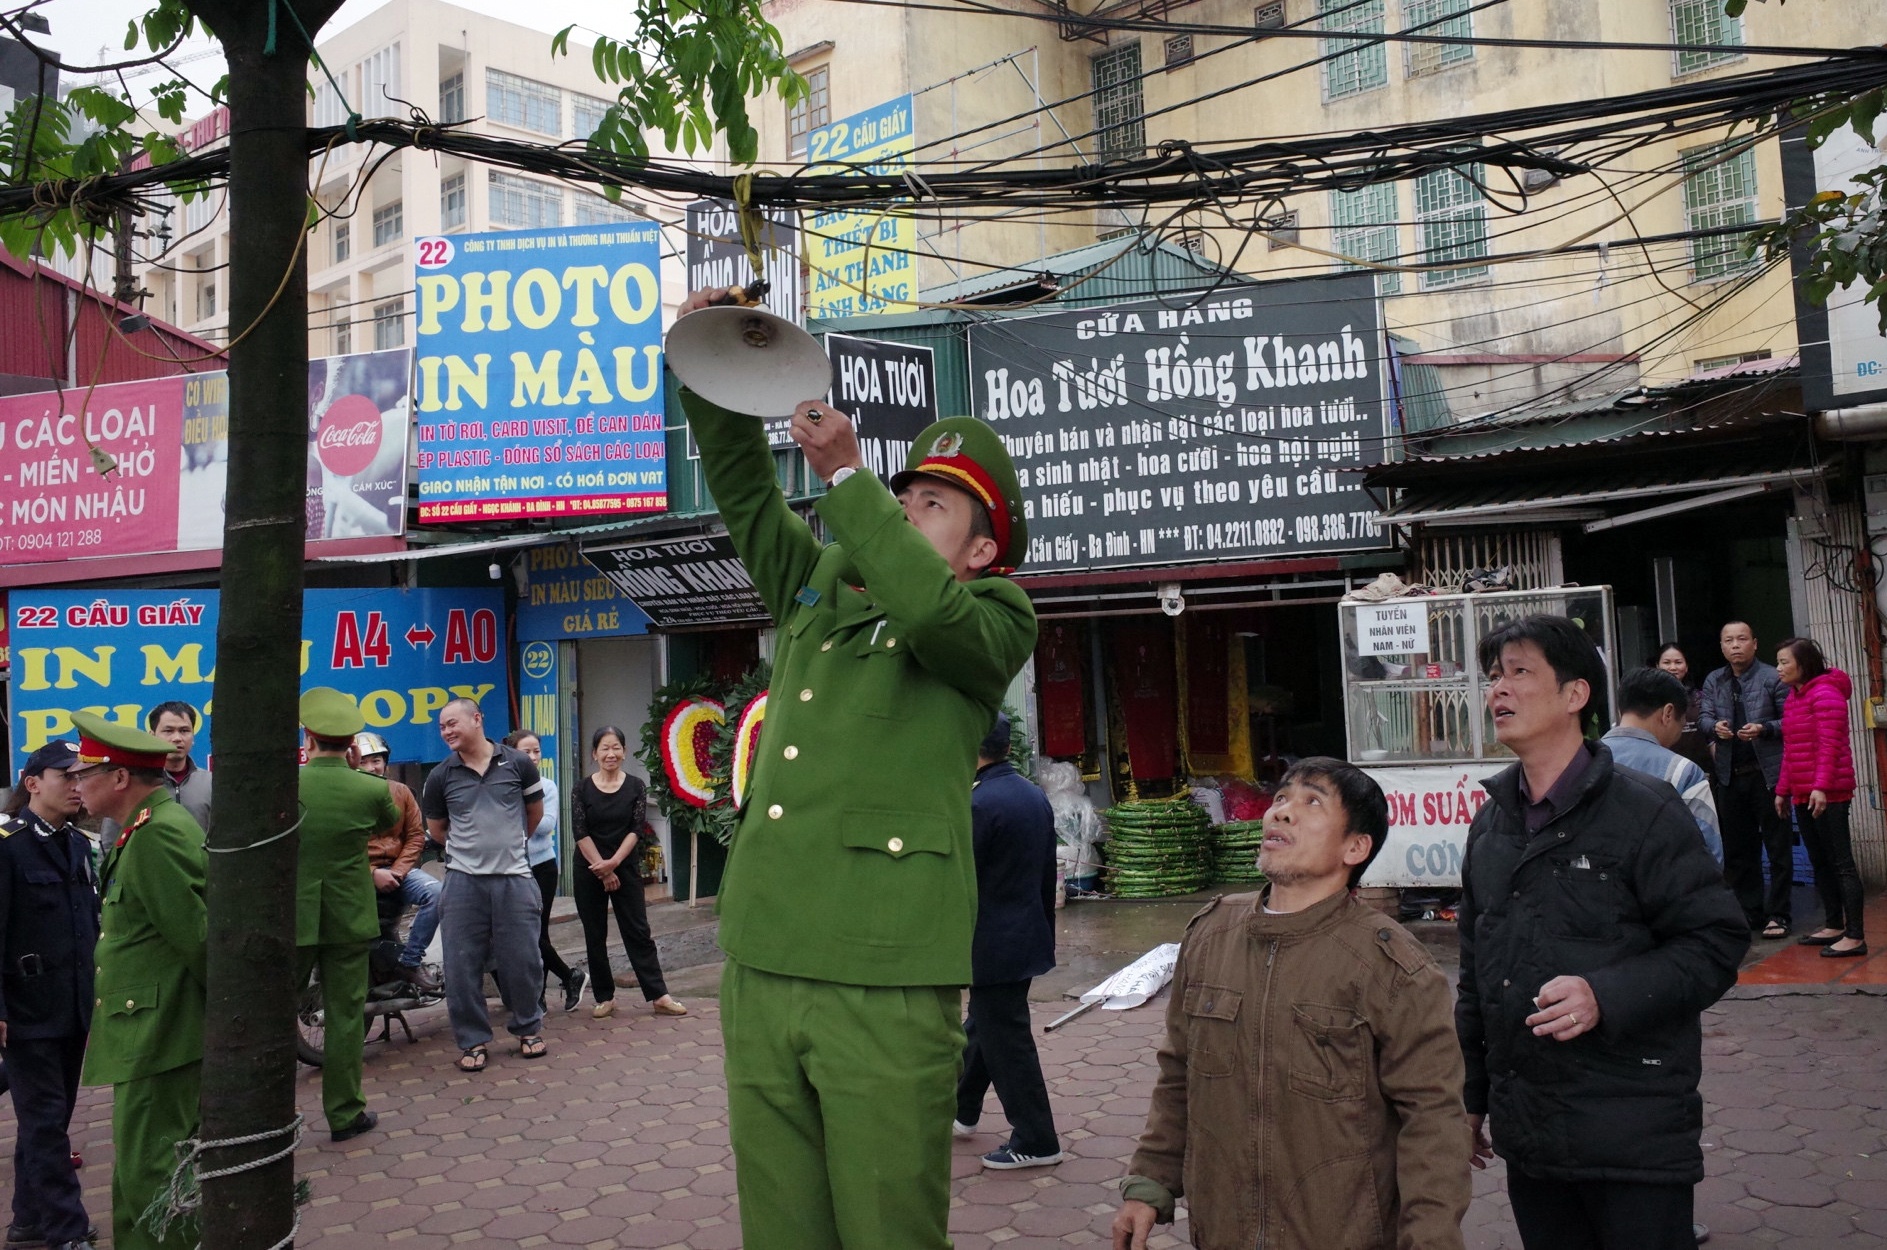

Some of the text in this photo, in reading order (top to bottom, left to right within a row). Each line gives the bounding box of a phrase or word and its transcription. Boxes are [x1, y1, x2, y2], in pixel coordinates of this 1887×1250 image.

[811, 104, 907, 164] 22 CẦU GIẤY
[697, 203, 738, 241] HOA
[823, 217, 898, 258] THIẾT BỊ
[419, 241, 447, 265] 22
[464, 239, 484, 253] CÔNG
[486, 240, 495, 251] TY
[496, 239, 516, 251] TNHH
[517, 238, 535, 252] DỊCH
[536, 237, 546, 251] VỤ
[547, 236, 556, 248] IN
[558, 233, 567, 247] VÀ
[569, 233, 598, 246] THƯƠNG
[600, 233, 614, 246] MẠI
[642, 228, 658, 244] VIỆT
[845, 248, 909, 283] THANH
[417, 263, 659, 335] PHOTO
[818, 283, 909, 318] ÁNH SÁNG
[1076, 298, 1253, 340] CỬA HÀNG
[418, 331, 661, 412] IN MÀU
[840, 354, 927, 408] HOA TƯƠI
[985, 324, 1368, 421] Hoa Tươi Hồng Khanh
[186, 376, 200, 408] CÓ
[15, 410, 76, 450] CÁC
[85, 404, 156, 446] LOẠI
[320, 420, 381, 449] Coca-Cola
[419, 423, 434, 442] IN
[439, 420, 456, 441] TỜ
[491, 420, 528, 438] CARD
[533, 418, 572, 437] VISIT,
[599, 416, 628, 434] CAN
[632, 411, 663, 432] DÁN
[784, 418, 792, 429] NỘ
[1059, 426, 1090, 452] bán
[1095, 422, 1115, 448] và
[1122, 418, 1162, 449] nhận
[1203, 410, 1235, 435] các
[1241, 406, 1275, 436] loại
[1281, 404, 1313, 429] hoa
[20, 448, 78, 488] MIẾN
[438, 449, 491, 468] PLASTIC
[503, 444, 539, 465] ĐÓNG
[565, 442, 601, 462] SÁCH
[605, 440, 631, 460] CÁC
[635, 441, 665, 462] LOẠI
[1036, 460, 1073, 487] sinh
[1079, 456, 1120, 486] nhật
[1137, 452, 1171, 477] hoa
[1237, 442, 1272, 467] hoa
[1279, 436, 1310, 468] hội
[419, 470, 663, 496] GIAO NHẬN TẬN NƠI CÓ HOÁ ĐƠN VAT
[1042, 490, 1083, 518] hiếu
[1103, 487, 1152, 517] phục
[1160, 485, 1185, 512] vụ
[1194, 479, 1240, 504] theo
[1248, 473, 1288, 504] yêu
[12, 492, 67, 525] MÓN
[75, 485, 146, 523] NHẬU
[441, 506, 449, 516] 22
[18, 528, 102, 550] 0904 121 288
[611, 548, 662, 562] HOA
[660, 540, 716, 557] TƯƠI
[1032, 535, 1052, 563] Cầu
[1055, 532, 1078, 563] Giấy
[1088, 533, 1102, 558] Ba
[1106, 531, 1130, 557] Đình
[1139, 528, 1156, 554] HN
[1184, 525, 1204, 551] ĐT:
[1206, 518, 1286, 550] 04.2211.0882
[531, 583, 546, 606] IN
[549, 576, 580, 604] MÀU
[605, 557, 754, 598] HỒNG KHAN
[17, 606, 59, 628] 22
[66, 598, 129, 628] CẦU
[137, 598, 205, 627] GIẤY
[563, 606, 620, 633] GIÁ RẺ
[1369, 624, 1416, 637] NHÂN VIÊN
[1376, 606, 1407, 621] TUYỂN
[331, 611, 391, 669] A4
[1373, 639, 1415, 651] NAM NỮ
[18, 646, 116, 691] IN
[527, 650, 549, 669] 22
[1385, 774, 1486, 826] ƠM SUẤT
